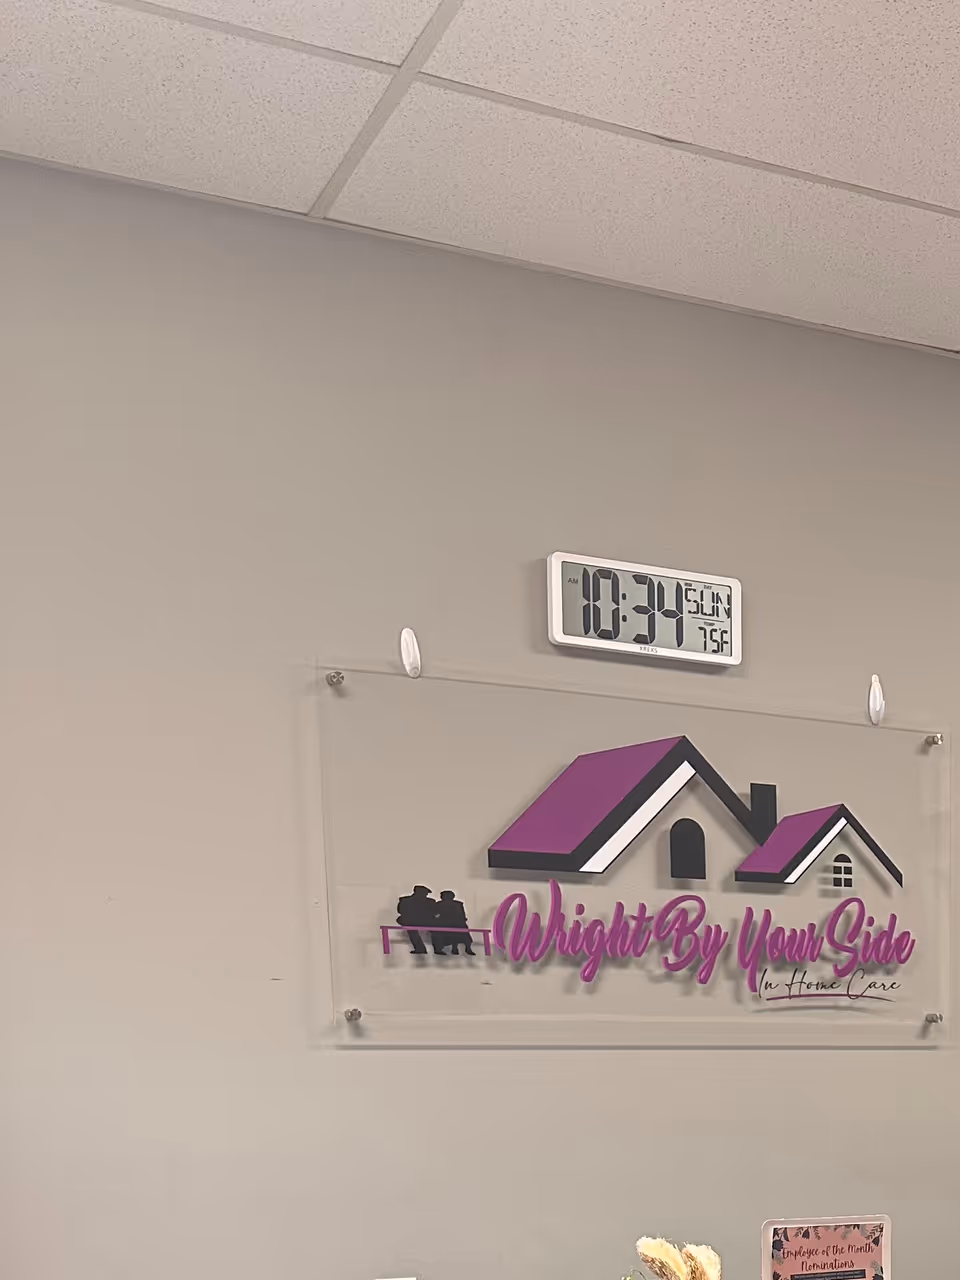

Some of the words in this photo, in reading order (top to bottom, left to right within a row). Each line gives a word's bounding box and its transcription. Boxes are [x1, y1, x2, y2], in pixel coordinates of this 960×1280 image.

[567, 577, 579, 585] AM
[582, 567, 684, 648] 10:34
[684, 587, 731, 619] SUN
[493, 879, 654, 983] Wright
[653, 894, 729, 985] By
[737, 906, 824, 993] Your
[826, 897, 916, 979] Side
[757, 968, 779, 999] In
[784, 968, 841, 1000] Home
[846, 967, 902, 1000] Care
[782, 1246, 820, 1260] Employee
[821, 1244, 831, 1257] of
[832, 1243, 846, 1255] the
[847, 1242, 875, 1254] Month
[801, 1257, 855, 1272] Nominations
